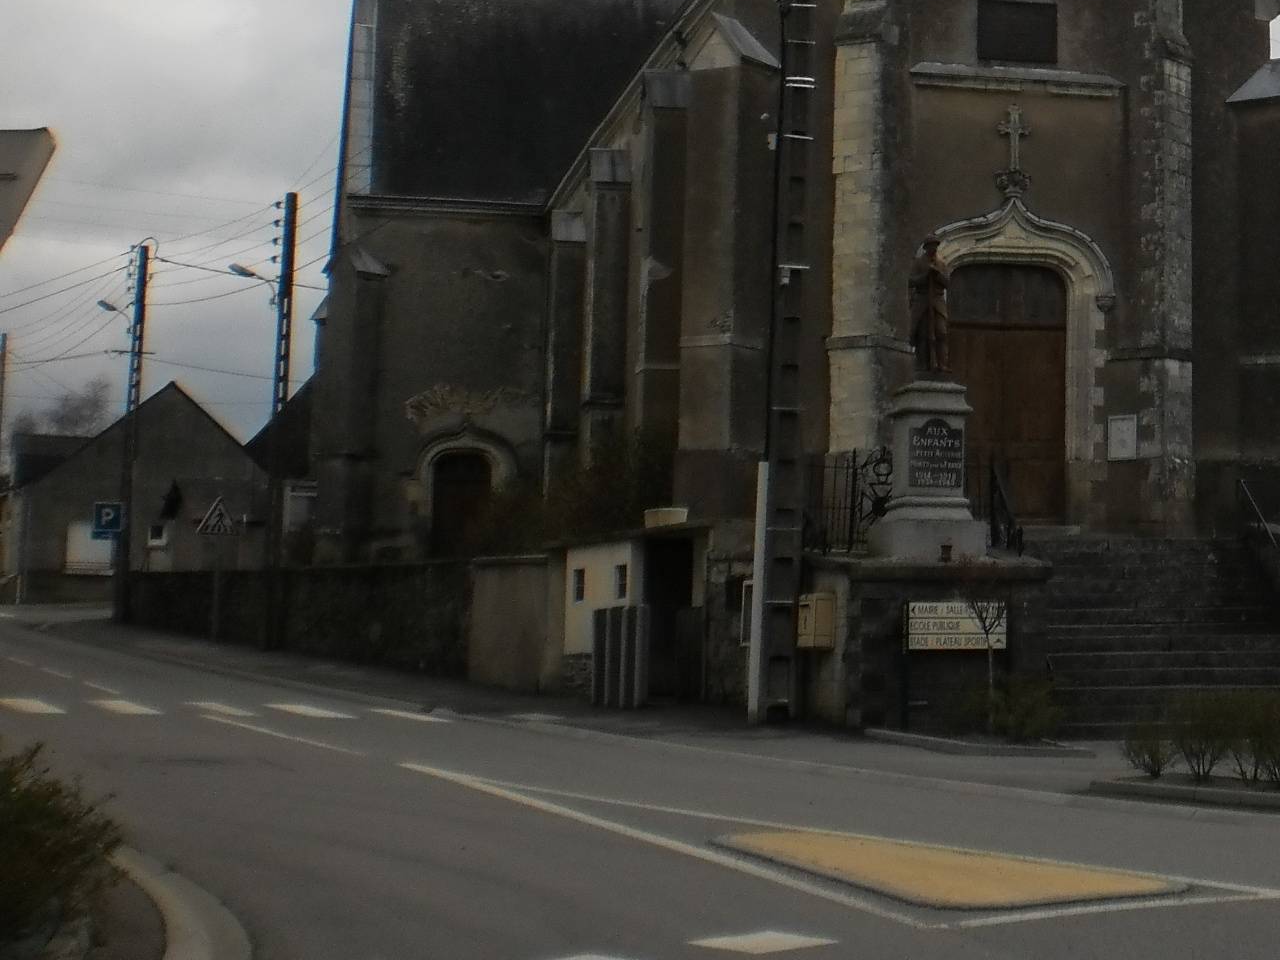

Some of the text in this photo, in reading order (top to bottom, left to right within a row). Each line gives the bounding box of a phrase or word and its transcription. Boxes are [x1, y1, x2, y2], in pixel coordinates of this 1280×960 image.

[927, 426, 948, 436] AUX
[913, 436, 961, 448] ENFANTS
[101, 508, 114, 526] P
